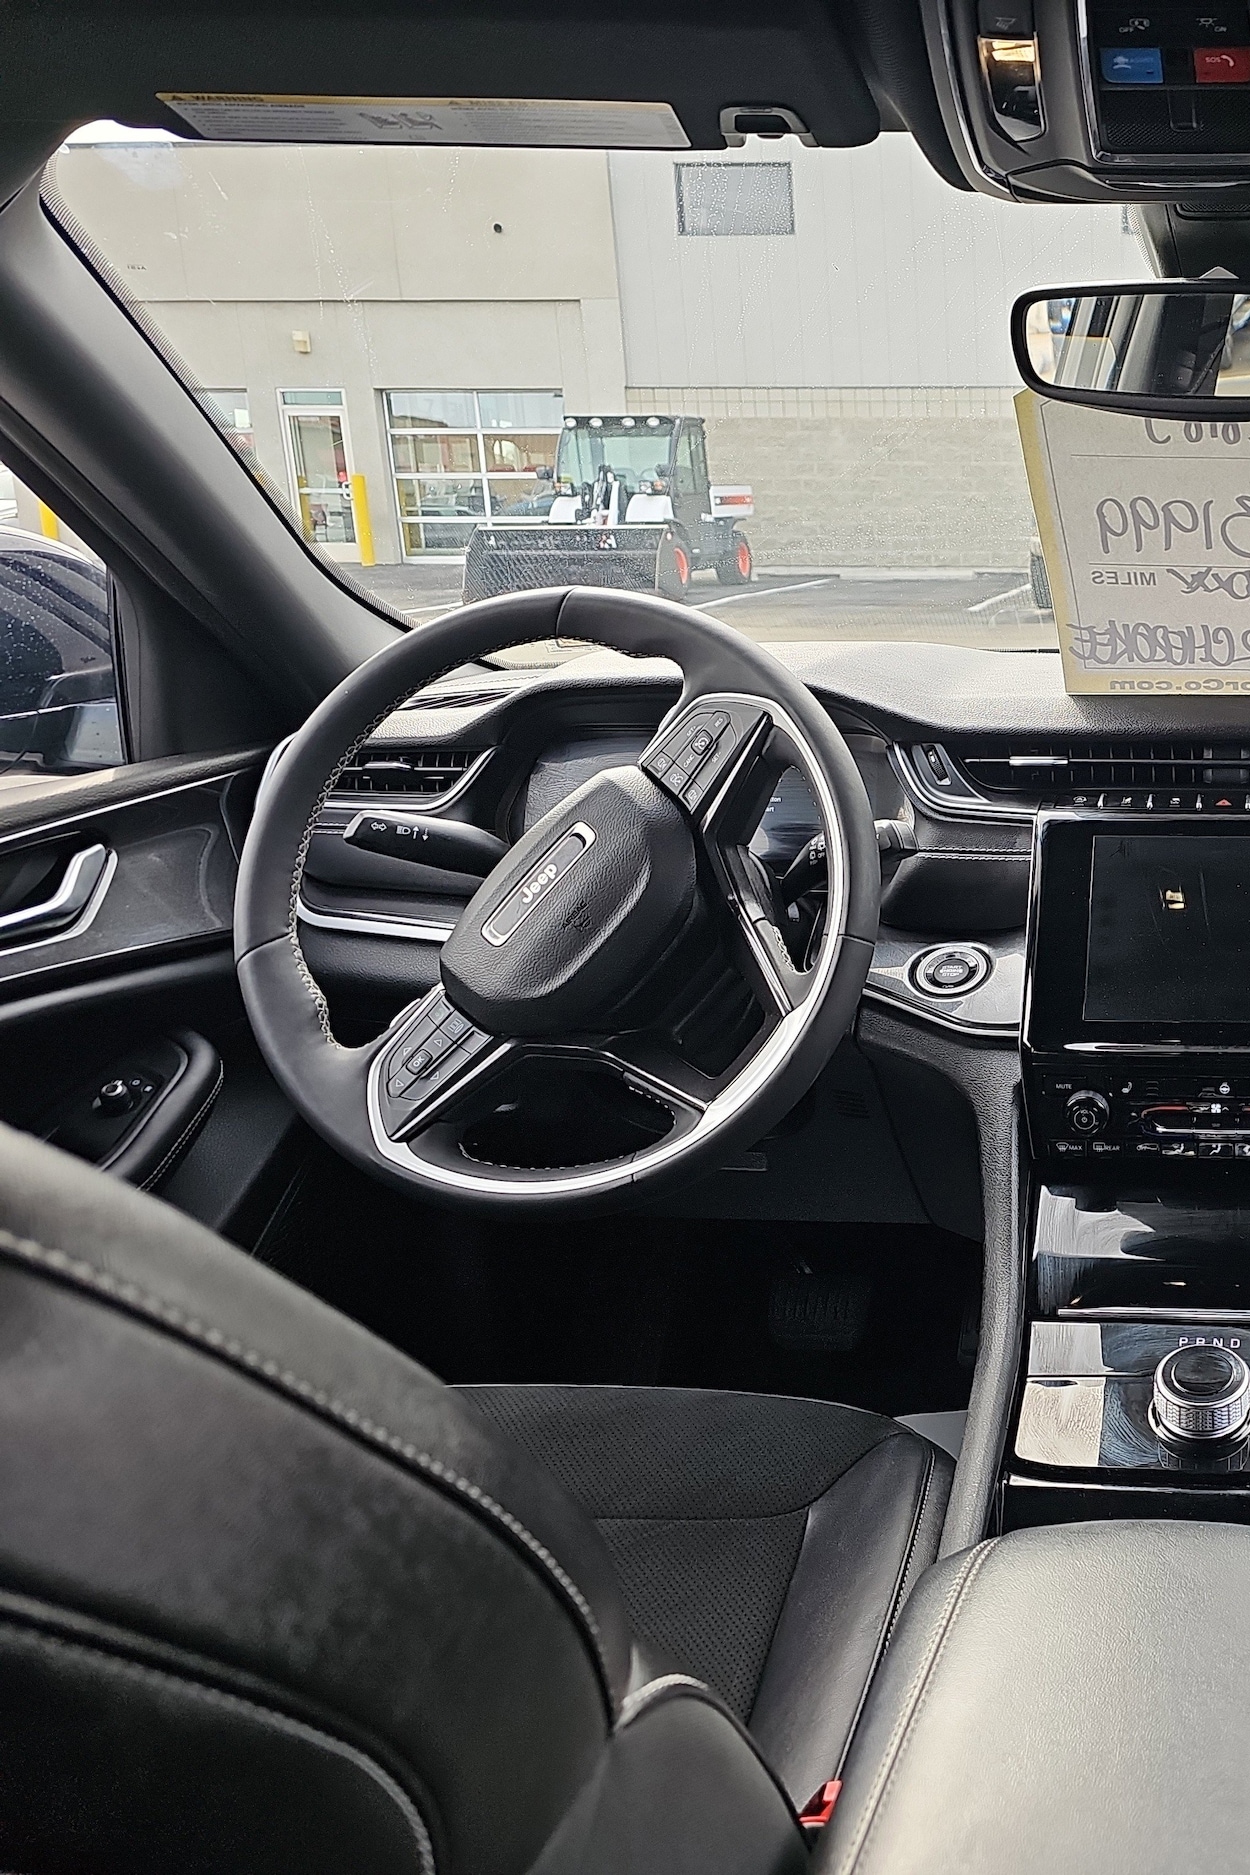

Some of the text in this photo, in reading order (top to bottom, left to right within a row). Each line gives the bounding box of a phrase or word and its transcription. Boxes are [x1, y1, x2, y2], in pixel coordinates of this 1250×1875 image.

[522, 864, 557, 904] Jeep
[412, 1056, 425, 1067] OK
[1179, 1337, 1189, 1347] P
[1212, 1338, 1224, 1347] N
[1230, 1338, 1241, 1349] D
